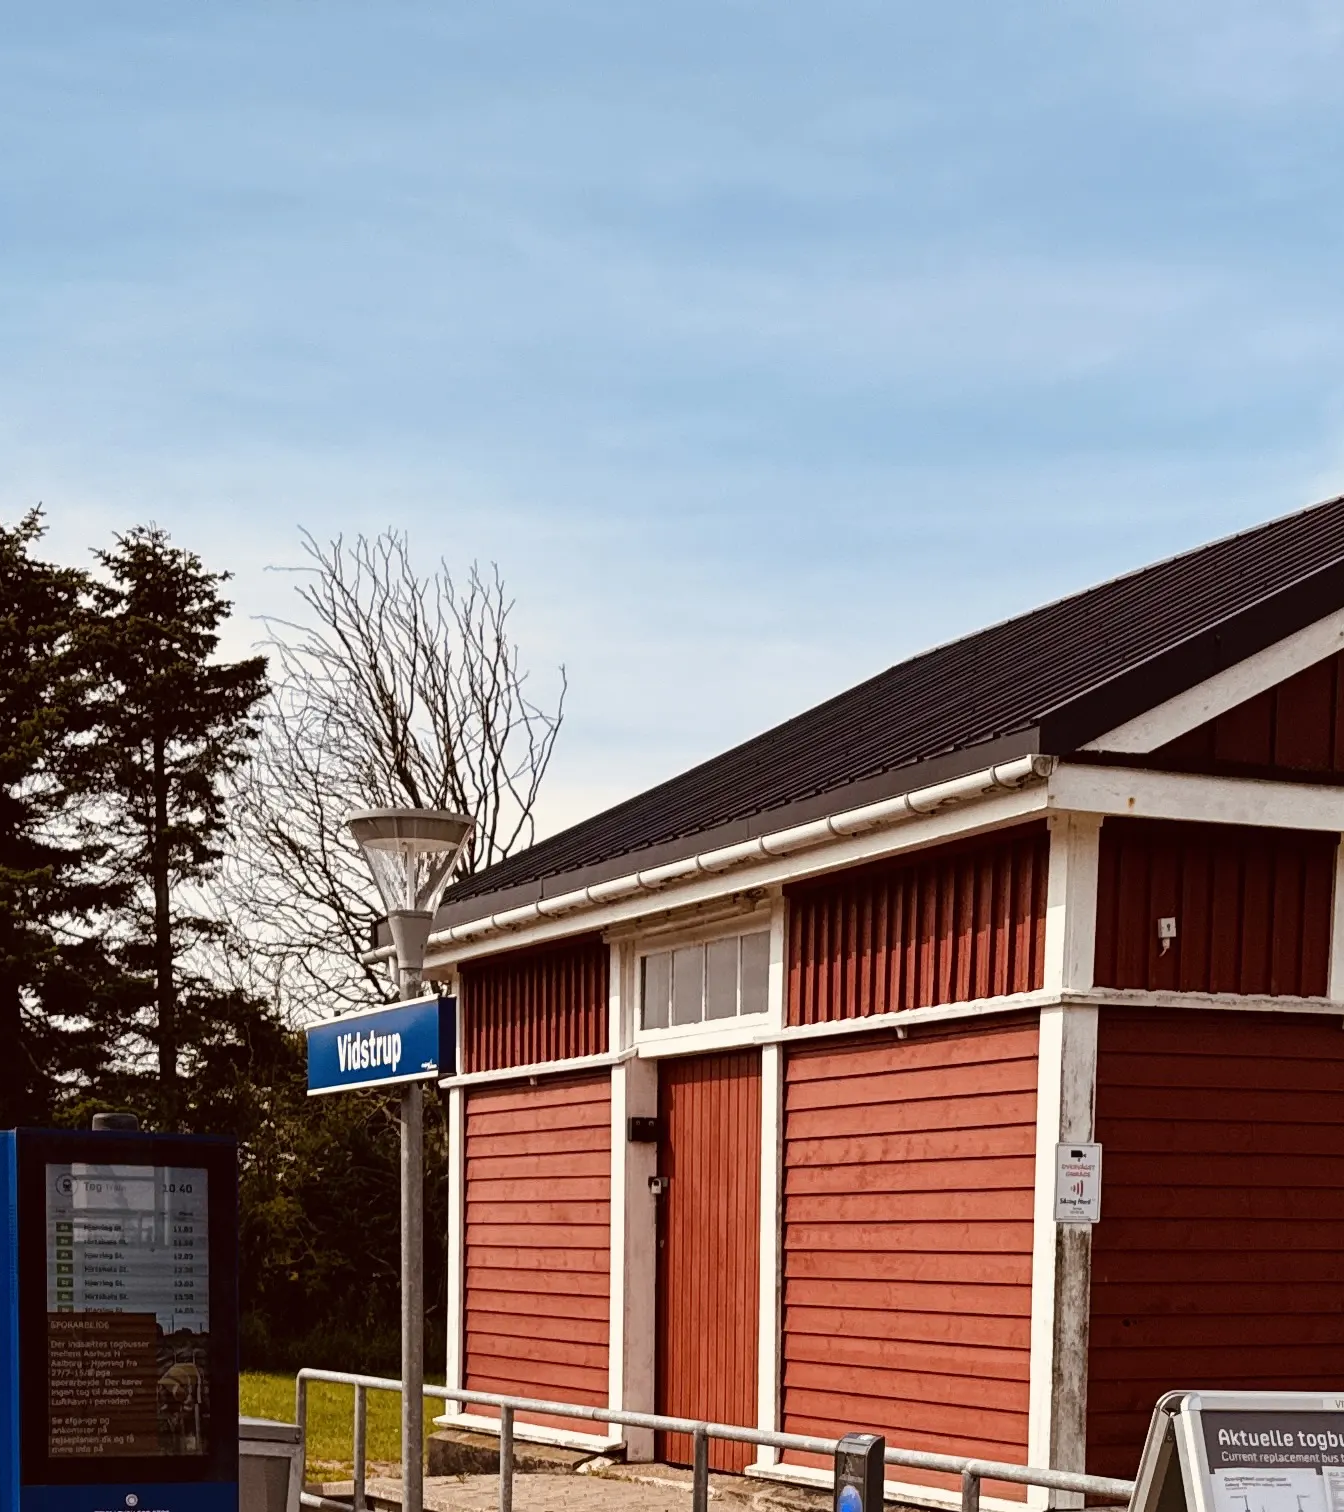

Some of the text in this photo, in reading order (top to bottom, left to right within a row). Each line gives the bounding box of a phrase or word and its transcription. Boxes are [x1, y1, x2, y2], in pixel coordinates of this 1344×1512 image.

[337, 1030, 401, 1072] Vidstrup
[1218, 1428, 1294, 1448] Aktuelle
[1222, 1451, 1258, 1463] Current
[1259, 1452, 1320, 1465] replacement
[1322, 1453, 1339, 1463] bus
